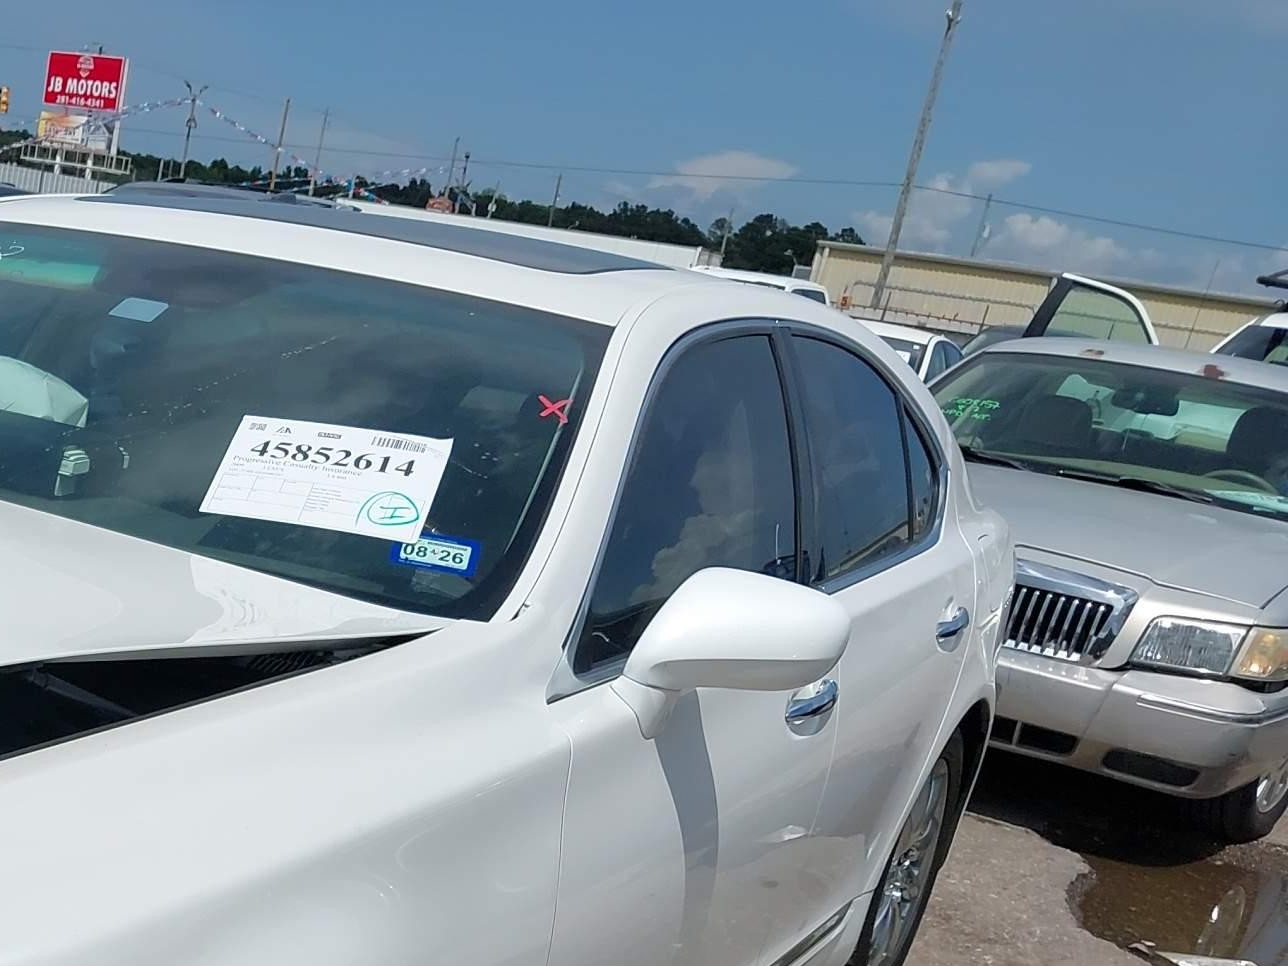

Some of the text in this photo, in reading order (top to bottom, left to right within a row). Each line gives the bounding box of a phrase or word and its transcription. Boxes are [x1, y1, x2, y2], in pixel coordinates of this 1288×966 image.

[47, 76, 117, 98] JB MOTORS
[249, 439, 416, 477] 45852614
[403, 543, 429, 558] 08
[438, 549, 465, 565] 26
